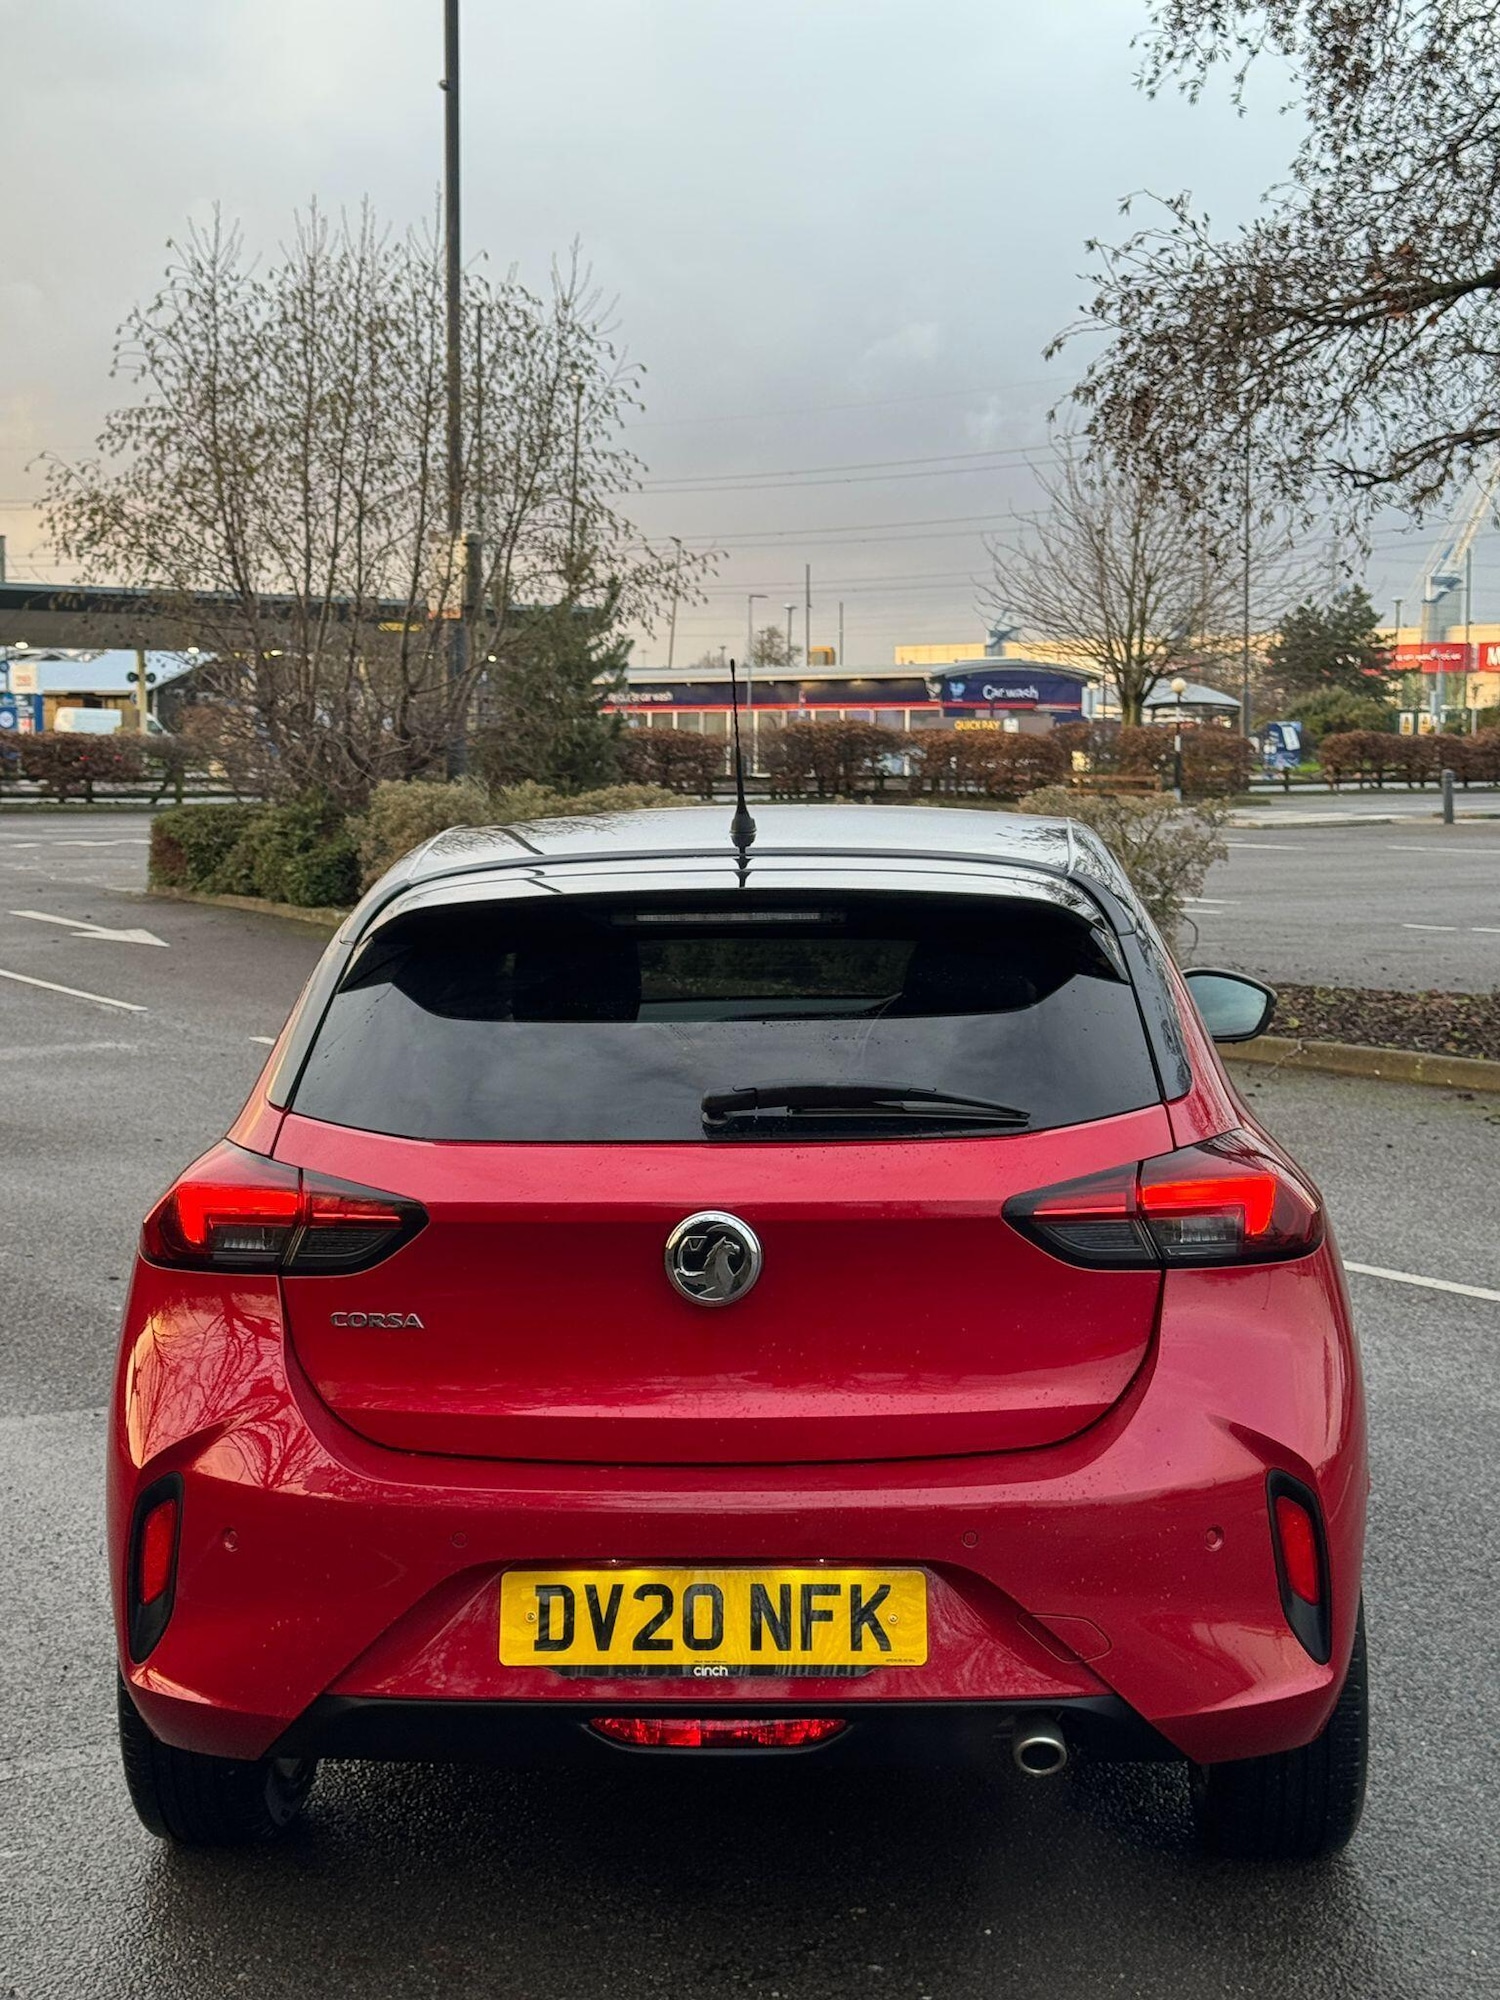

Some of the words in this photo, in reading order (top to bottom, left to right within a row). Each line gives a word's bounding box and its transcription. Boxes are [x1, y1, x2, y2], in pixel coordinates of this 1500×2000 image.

[982, 685, 1005, 700] Car
[1006, 685, 1039, 700] wash
[954, 720, 981, 731] QUICK
[330, 1312, 424, 1329] CORSA
[533, 1583, 724, 1652] DV20
[750, 1583, 892, 1652] NFK
[693, 1665, 728, 1677] cinch
